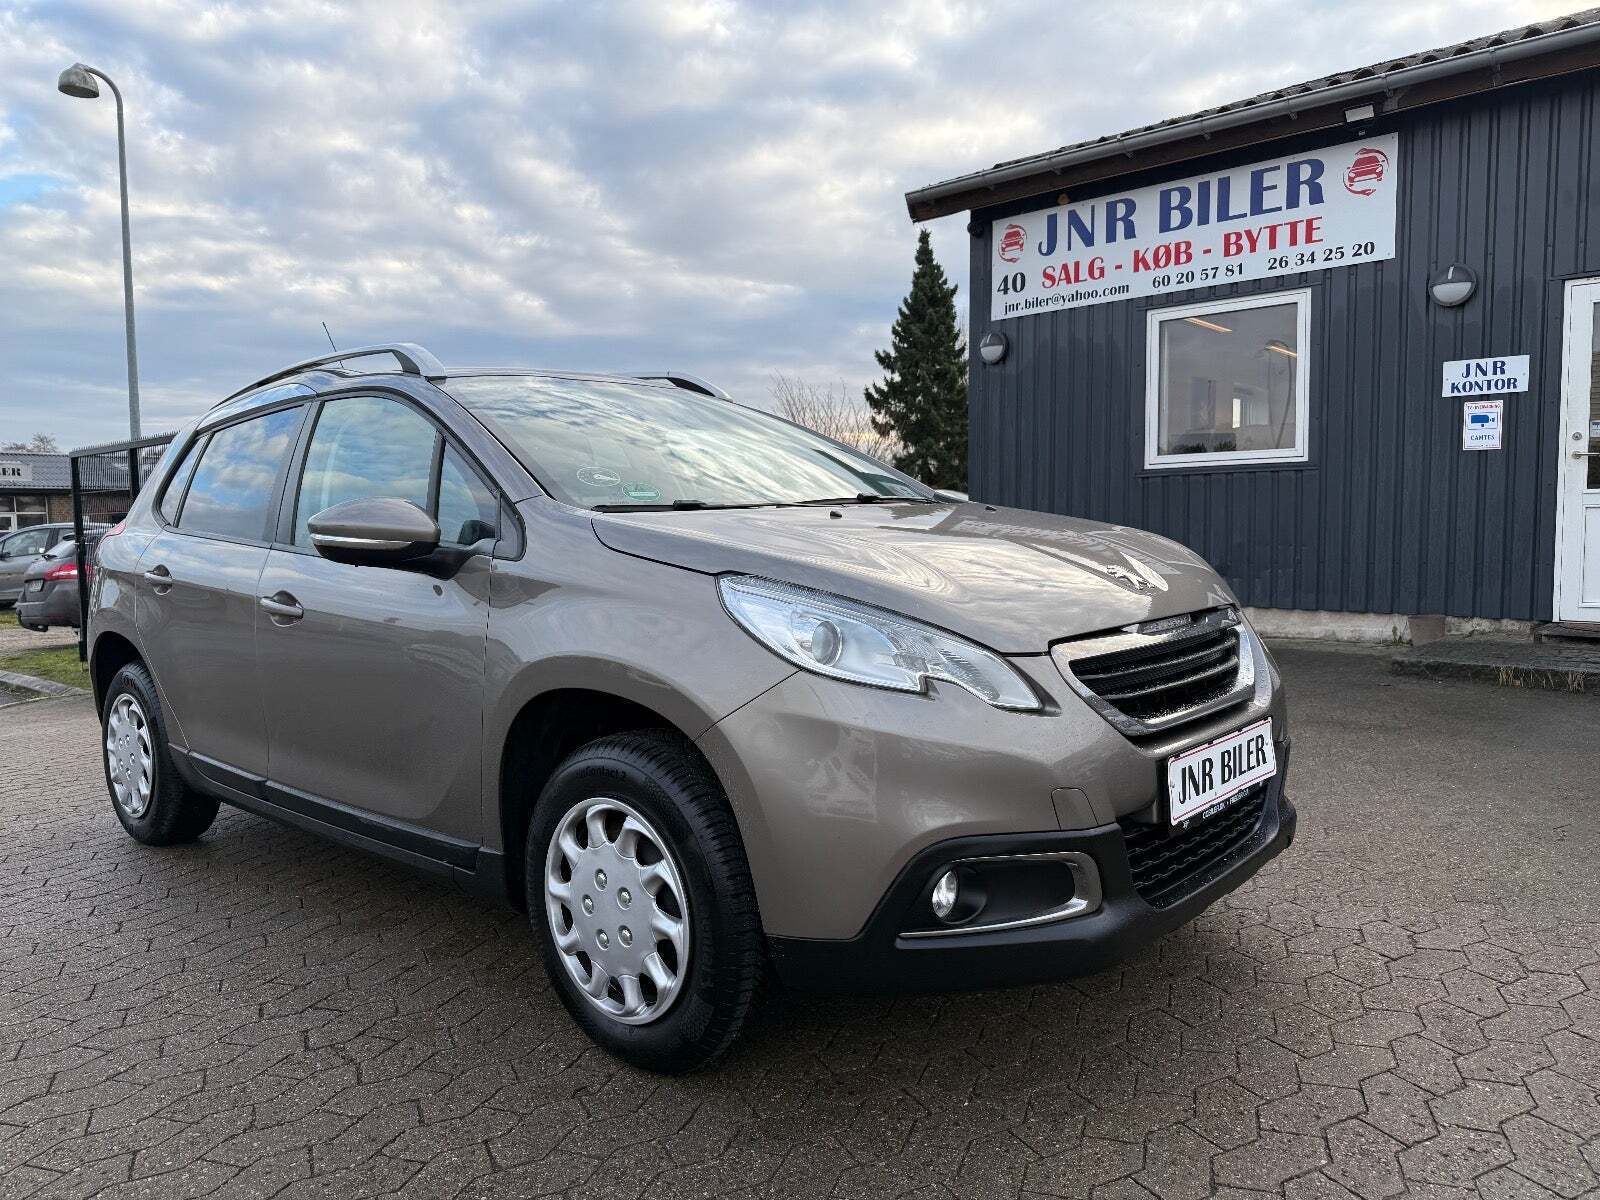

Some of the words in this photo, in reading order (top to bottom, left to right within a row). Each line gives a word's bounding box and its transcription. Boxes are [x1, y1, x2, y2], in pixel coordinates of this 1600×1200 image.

[1037, 197, 1138, 257] JNR
[1158, 157, 1326, 234] BILER
[1041, 256, 1105, 289] SALG
[1132, 241, 1193, 273] KØB
[1223, 216, 1324, 258] BYTTE
[1268, 256, 1289, 270] 26
[1294, 251, 1317, 267] 34
[1323, 246, 1345, 262] 25
[1351, 241, 1376, 258] 20
[996, 271, 1027, 296] 40
[1152, 275, 1171, 289] 60
[1175, 271, 1195, 285] 20
[1200, 267, 1220, 281] 57
[1224, 263, 1243, 277] 81
[1003, 284, 1130, 316] jnr.biler@yahoo.com
[1461, 360, 1506, 379] JNR
[1450, 377, 1518, 394] KONTOR
[1178, 757, 1215, 805] JNR
[1220, 733, 1268, 785] BILER
